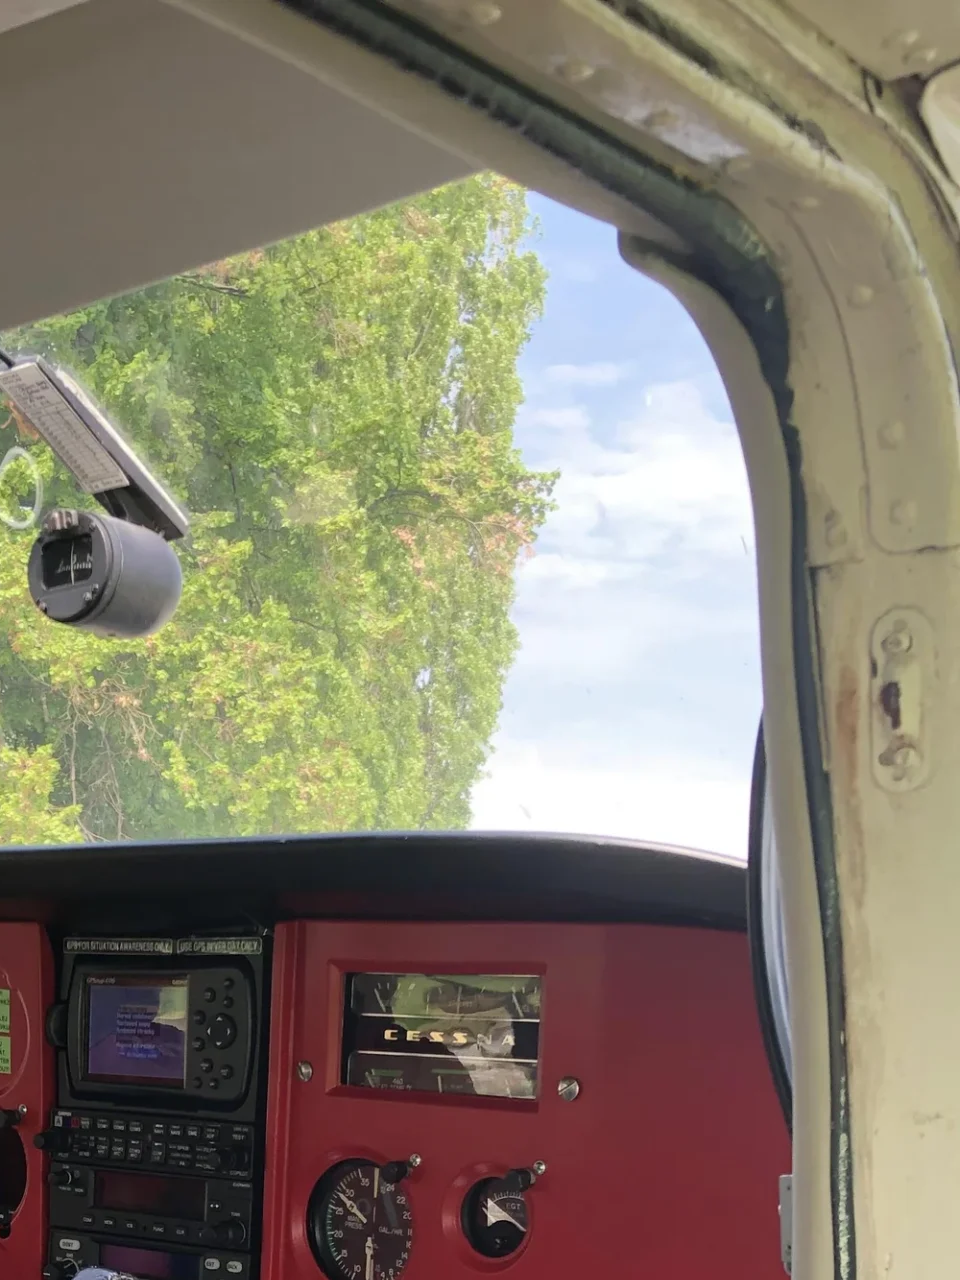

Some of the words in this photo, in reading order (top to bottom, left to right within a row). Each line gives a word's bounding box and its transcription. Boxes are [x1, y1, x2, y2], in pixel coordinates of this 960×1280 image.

[90, 941, 119, 951] SITUATION
[120, 941, 154, 952] AWARENESS
[194, 941, 206, 951] GPS
[383, 1028, 516, 1047] CESSNA
